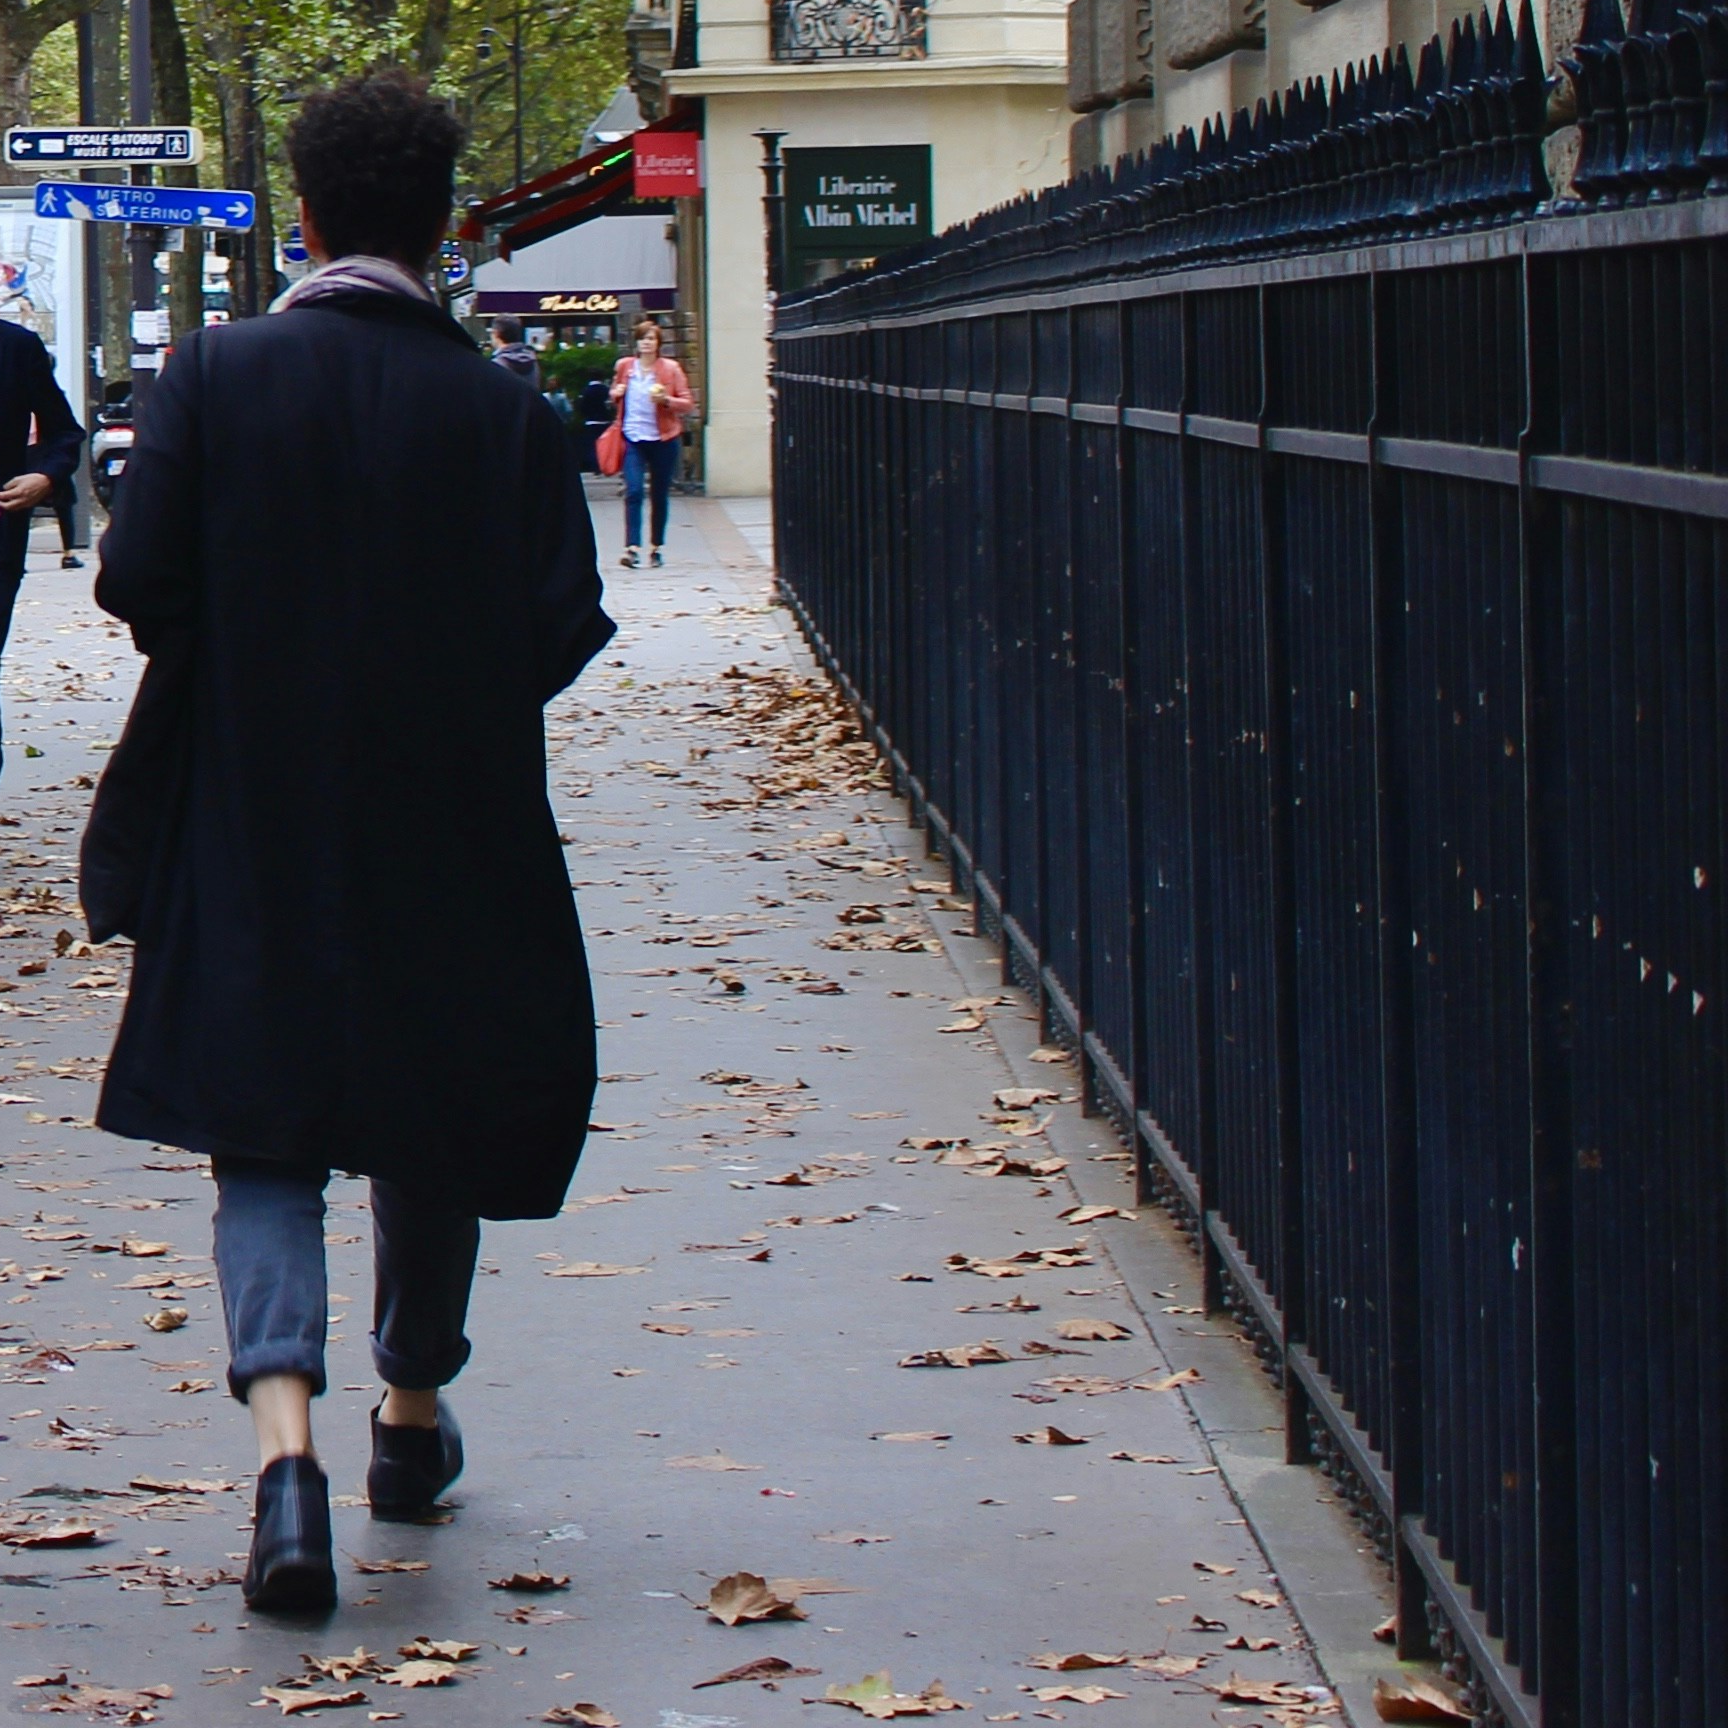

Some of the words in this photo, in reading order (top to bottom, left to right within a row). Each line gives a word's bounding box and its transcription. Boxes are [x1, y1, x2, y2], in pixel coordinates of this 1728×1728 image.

[66, 134, 164, 146] ESCALE-BATOBUS
[819, 176, 896, 195] Librairie
[96, 189, 156, 203] METRO
[96, 206, 192, 220] SLFERINO
[804, 205, 852, 227] Albin
[856, 203, 917, 226] Michel
